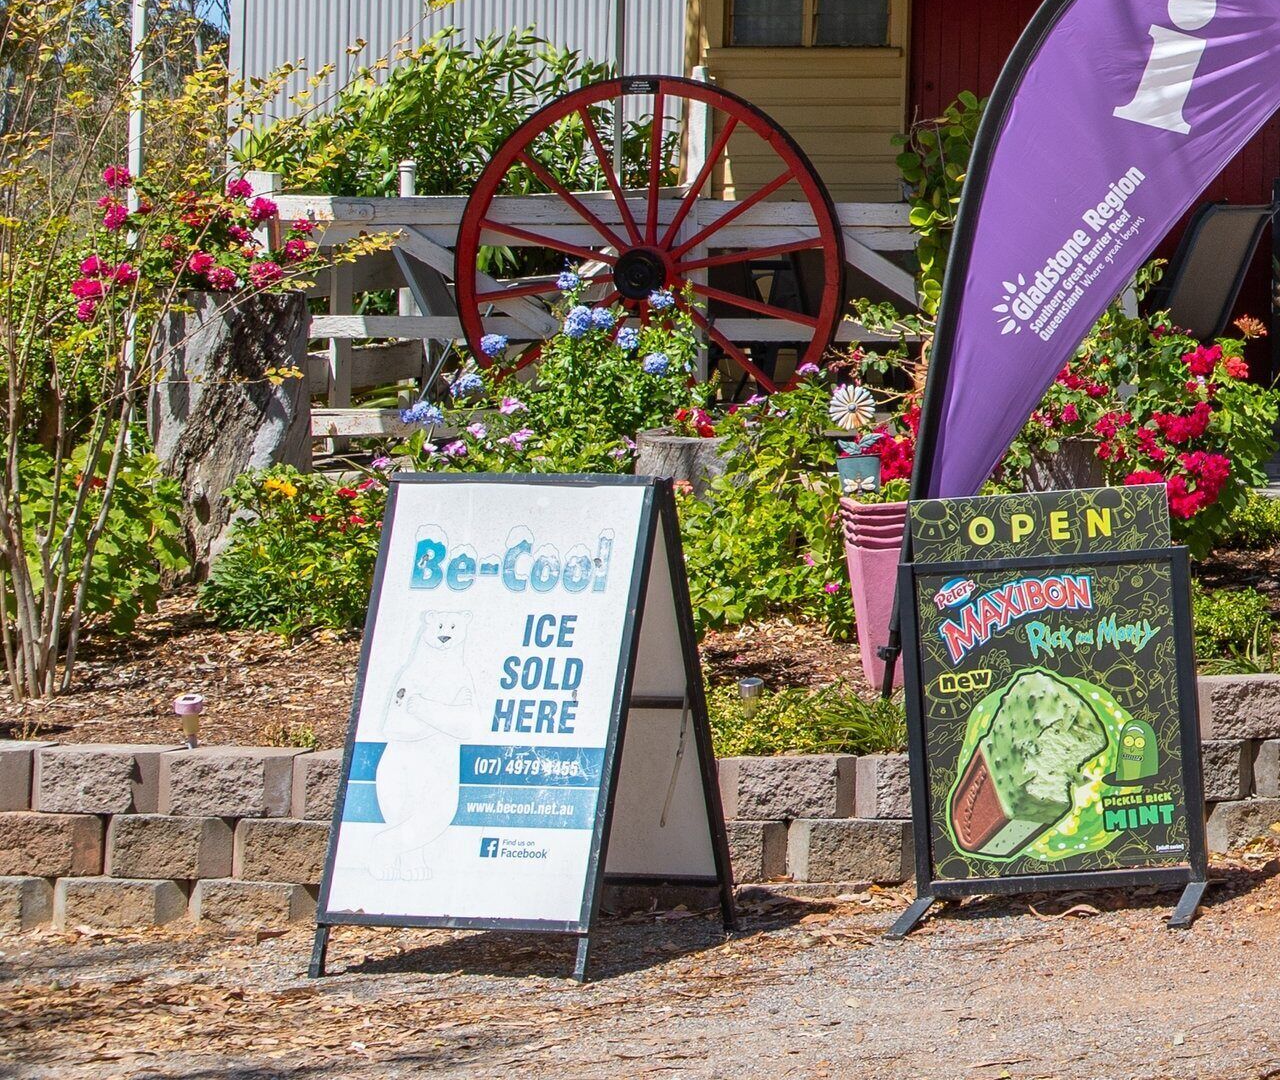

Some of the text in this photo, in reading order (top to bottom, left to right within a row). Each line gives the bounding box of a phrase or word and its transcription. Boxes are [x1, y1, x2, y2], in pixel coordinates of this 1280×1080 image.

[1012, 166, 1146, 321] Gladstone Region
[1029, 208, 1132, 334] Southern Great Barrier Reef
[1039, 216, 1146, 342] Queensland Where great begins
[967, 507, 1113, 547] OPEN
[409, 523, 616, 594] Be-Cool
[934, 577, 981, 611] Peters
[522, 613, 579, 648] ICE
[937, 573, 1096, 667] MAXIBON
[1024, 619, 1075, 660] Rick
[1096, 611, 1161, 654] Morty
[499, 655, 584, 691] SOLD
[939, 669, 992, 694] new
[490, 698, 579, 734] HERE
[474, 757, 502, 776] (07)
[504, 759, 541, 776] 4979
[466, 801, 574, 816] www.becool.net.au
[1103, 791, 1173, 808] PICKLE RICK
[1104, 804, 1175, 831] MINT
[500, 848, 548, 859] Facebook
[502, 838, 517, 846] Find
